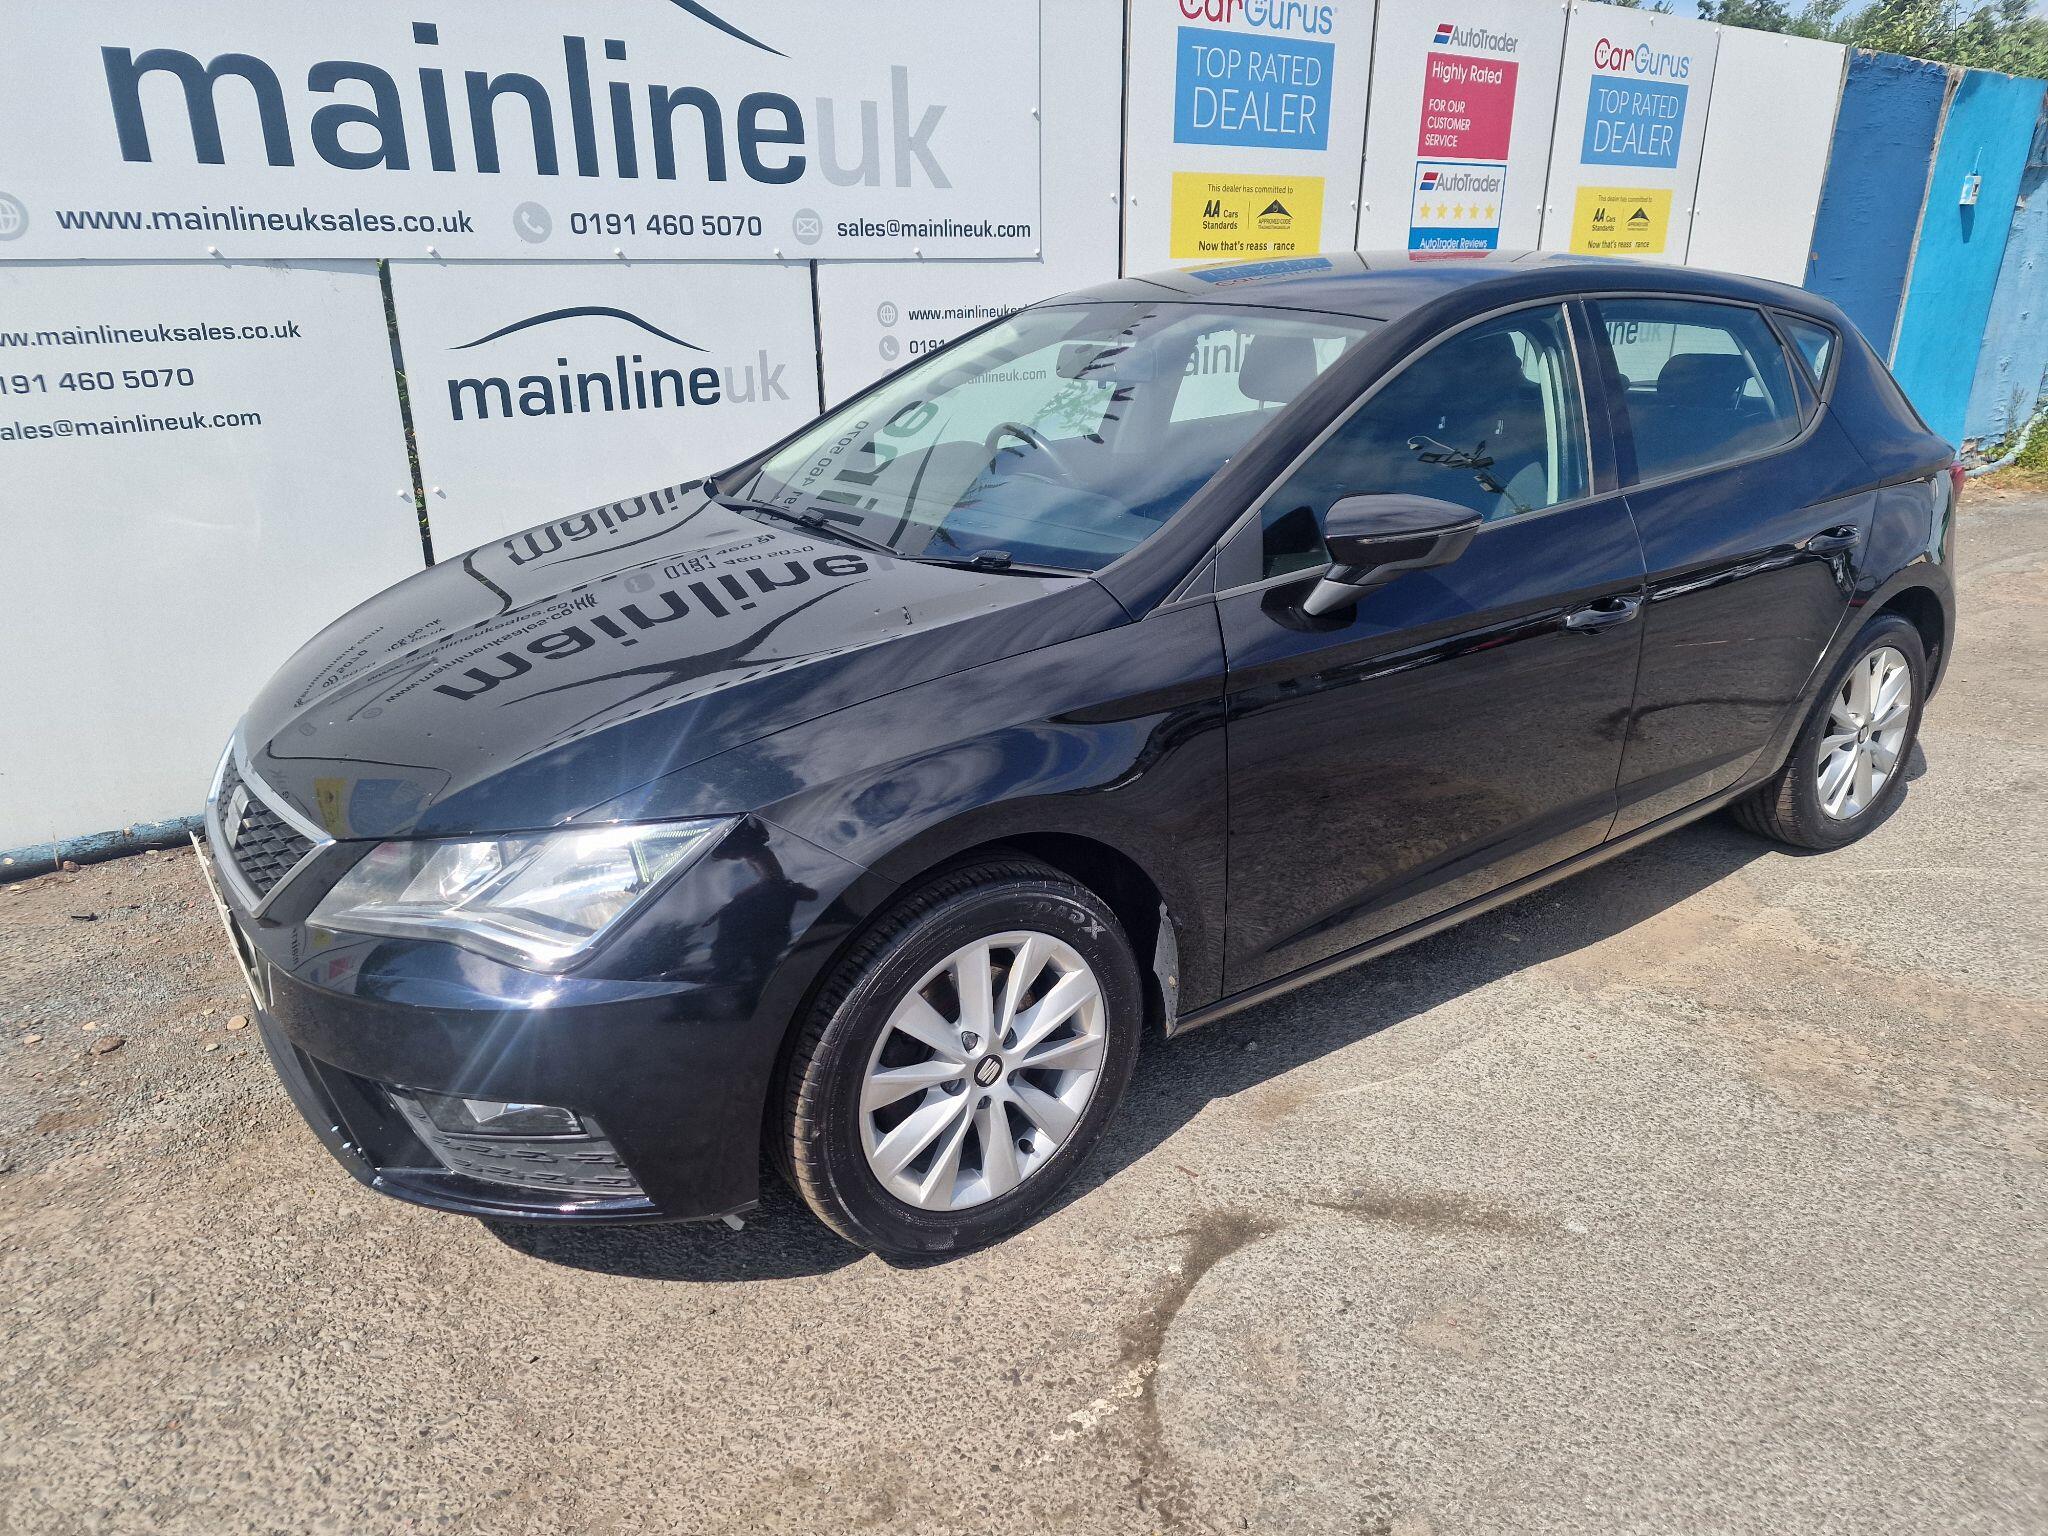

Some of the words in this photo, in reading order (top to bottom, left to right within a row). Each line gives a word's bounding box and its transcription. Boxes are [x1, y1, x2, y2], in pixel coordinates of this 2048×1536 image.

[1450, 25, 1519, 53] AutoTrader
[1191, 45, 1242, 79] TOP
[1248, 51, 1322, 87] RATED
[1594, 37, 1690, 79] CarGurus
[1432, 60, 1468, 84] Highly
[1470, 65, 1503, 84] Rated
[100, 22, 953, 190] mainlineuk
[1193, 86, 1317, 135] DEALER
[1429, 98, 1446, 112] FOR
[1448, 100, 1466, 114] OUR
[1598, 88, 1630, 114] TOP
[1632, 92, 1679, 119] RATED
[1427, 116, 1471, 131] CUSTOMER
[1424, 133, 1459, 147] SERVICE
[1593, 120, 1674, 156] DEALER
[1207, 184, 1221, 192] This
[1222, 184, 1242, 193] dealer
[1242, 185, 1254, 193] has
[1255, 185, 1286, 194] committed
[1435, 172, 1500, 193] AutoTrader
[55, 205, 475, 235] www.mainlineuksales.co.uk
[1203, 200, 1221, 218] AA
[1223, 209, 1239, 218] Cars
[1593, 207, 1606, 222] AA
[570, 212, 637, 236] 0191
[646, 213, 695, 236] 460
[701, 214, 763, 237] 5070
[836, 219, 1032, 239] sales@mainlineuk.com
[1202, 221, 1238, 230] Standards
[1592, 224, 1615, 232] Standards
[1198, 241, 1219, 251] Now
[1220, 240, 1244, 251] that's
[1246, 243, 1296, 251] reassrance
[1419, 237, 1460, 249] AutoTrader
[1460, 238, 1488, 249] Reviews
[1587, 240, 1601, 249] Now
[1601, 239, 1617, 249] that's
[1617, 240, 1650, 249] reassrance
[0, 320, 302, 347] w.mainlineuksales.co.uk
[58, 371, 115, 393] 460
[122, 367, 195, 390] 5070
[447, 348, 790, 421] mainlineuk
